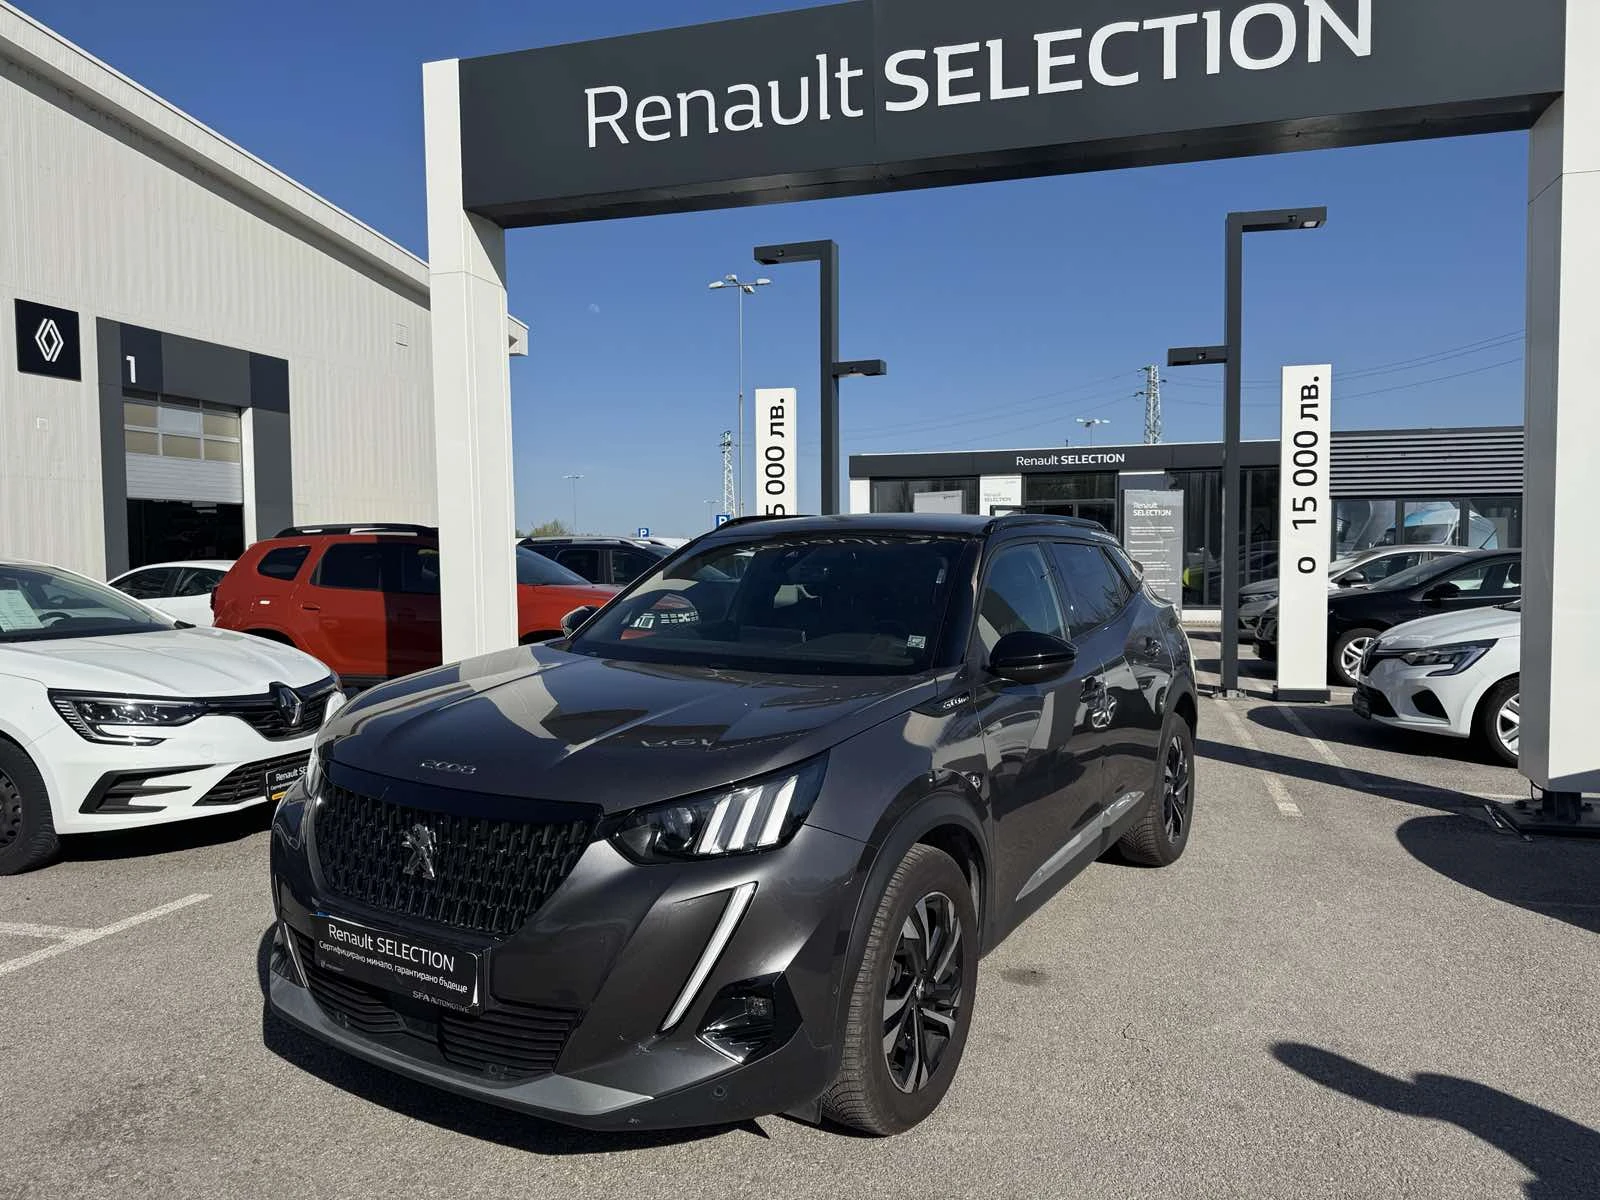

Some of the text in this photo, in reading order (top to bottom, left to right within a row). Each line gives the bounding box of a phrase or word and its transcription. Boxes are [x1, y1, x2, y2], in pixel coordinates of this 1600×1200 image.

[585, 0, 1372, 148] Renault SELECTION
[126, 355, 136, 384] 1
[770, 398, 785, 438] лв.
[1300, 375, 1320, 422] лв.
[765, 446, 785, 495] 000
[1016, 453, 1126, 466] Renault SELECTION
[1292, 430, 1319, 487] 000
[1292, 496, 1318, 530] 15
[640, 529, 647, 538] P
[275, 768, 299, 782] Renault
[318, 940, 366, 964] Сертифицирано
[394, 964, 438, 984] гарантирано
[438, 976, 468, 993] бъдеще
[328, 923, 374, 951] Renault
[376, 937, 455, 973] SELECTION
[412, 990, 430, 1002] SFA
